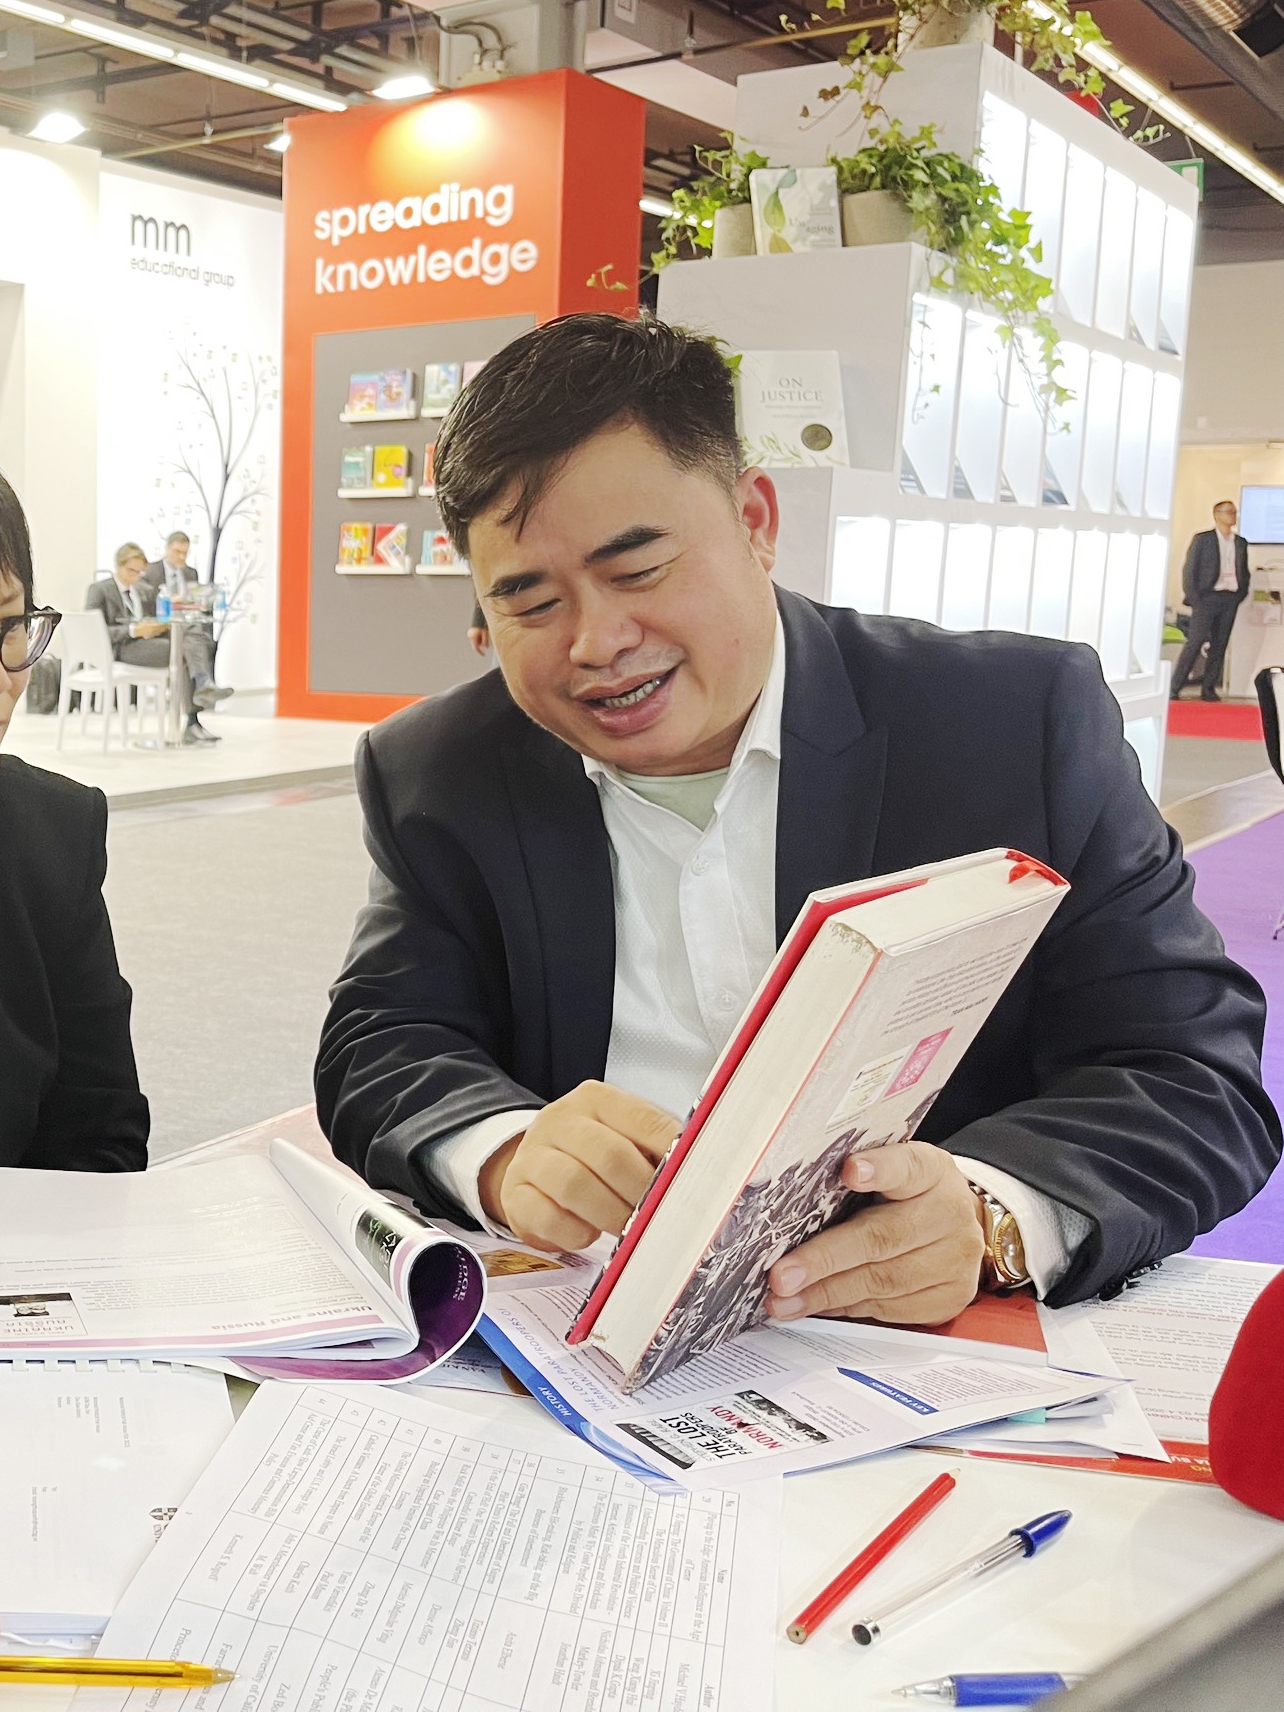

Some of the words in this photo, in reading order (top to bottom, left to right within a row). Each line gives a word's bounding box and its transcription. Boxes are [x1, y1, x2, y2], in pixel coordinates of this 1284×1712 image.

[314, 182, 514, 246] spreading
[130, 213, 190, 256] mm
[130, 257, 200, 281] educational
[203, 271, 236, 289] group
[315, 237, 539, 295] knowledge
[778, 377, 803, 388] ON
[760, 390, 823, 403] JUSTICE
[270, 1314, 301, 1324] and
[307, 1304, 373, 1317] Ukraine
[211, 1320, 266, 1330] Russia
[508, 1314, 569, 1379] PARATROOPERS
[563, 1375, 588, 1397] LOST
[571, 1366, 620, 1411] NORMANDY
[869, 1381, 914, 1405] FEATURES
[537, 1385, 572, 1417] HISTORY
[584, 1396, 606, 1413] THE
[910, 1402, 930, 1413] KEY
[659, 1416, 702, 1440] LOST
[680, 1411, 753, 1455] PARATROOPERS
[706, 1405, 785, 1450] NORMANDY
[697, 1439, 737, 1460] THE
[596, 1492, 605, 1502] The
[725, 1498, 733, 1509] No.
[589, 1500, 603, 1524] Righteous
[636, 1506, 651, 1540] Understanding
[223, 1533, 243, 1555] Kenneth
[582, 1537, 595, 1551] Why
[634, 1539, 645, 1564] Terrorism
[581, 1550, 592, 1565] Good
[632, 1563, 641, 1574] and
[205, 1560, 226, 1581] Rogoff
[574, 1563, 588, 1582] People
[717, 1567, 726, 1584] Name
[357, 1580, 374, 1598] Zhang
[574, 1581, 584, 1593] Are
[628, 1572, 639, 1595] Political
[350, 1606, 362, 1619] Wei
[569, 1592, 582, 1614] Divided
[623, 1594, 635, 1619] Violence
[167, 1628, 193, 1661] Princeto
[597, 1628, 610, 1655] Nicholas
[250, 1643, 279, 1683] University
[556, 1641, 570, 1668] Jonathan
[313, 1662, 337, 1694] People's
[551, 1667, 564, 1686] Haidt
[567, 1643, 588, 1691] Markey-Towler
[592, 1654, 605, 1679] Johnson
[677, 1661, 688, 1688] Michael
[275, 1682, 291, 1700] Zed
[589, 1678, 600, 1691] and
[643, 1676, 658, 1701] Jinping
[702, 1683, 713, 1708] Author
